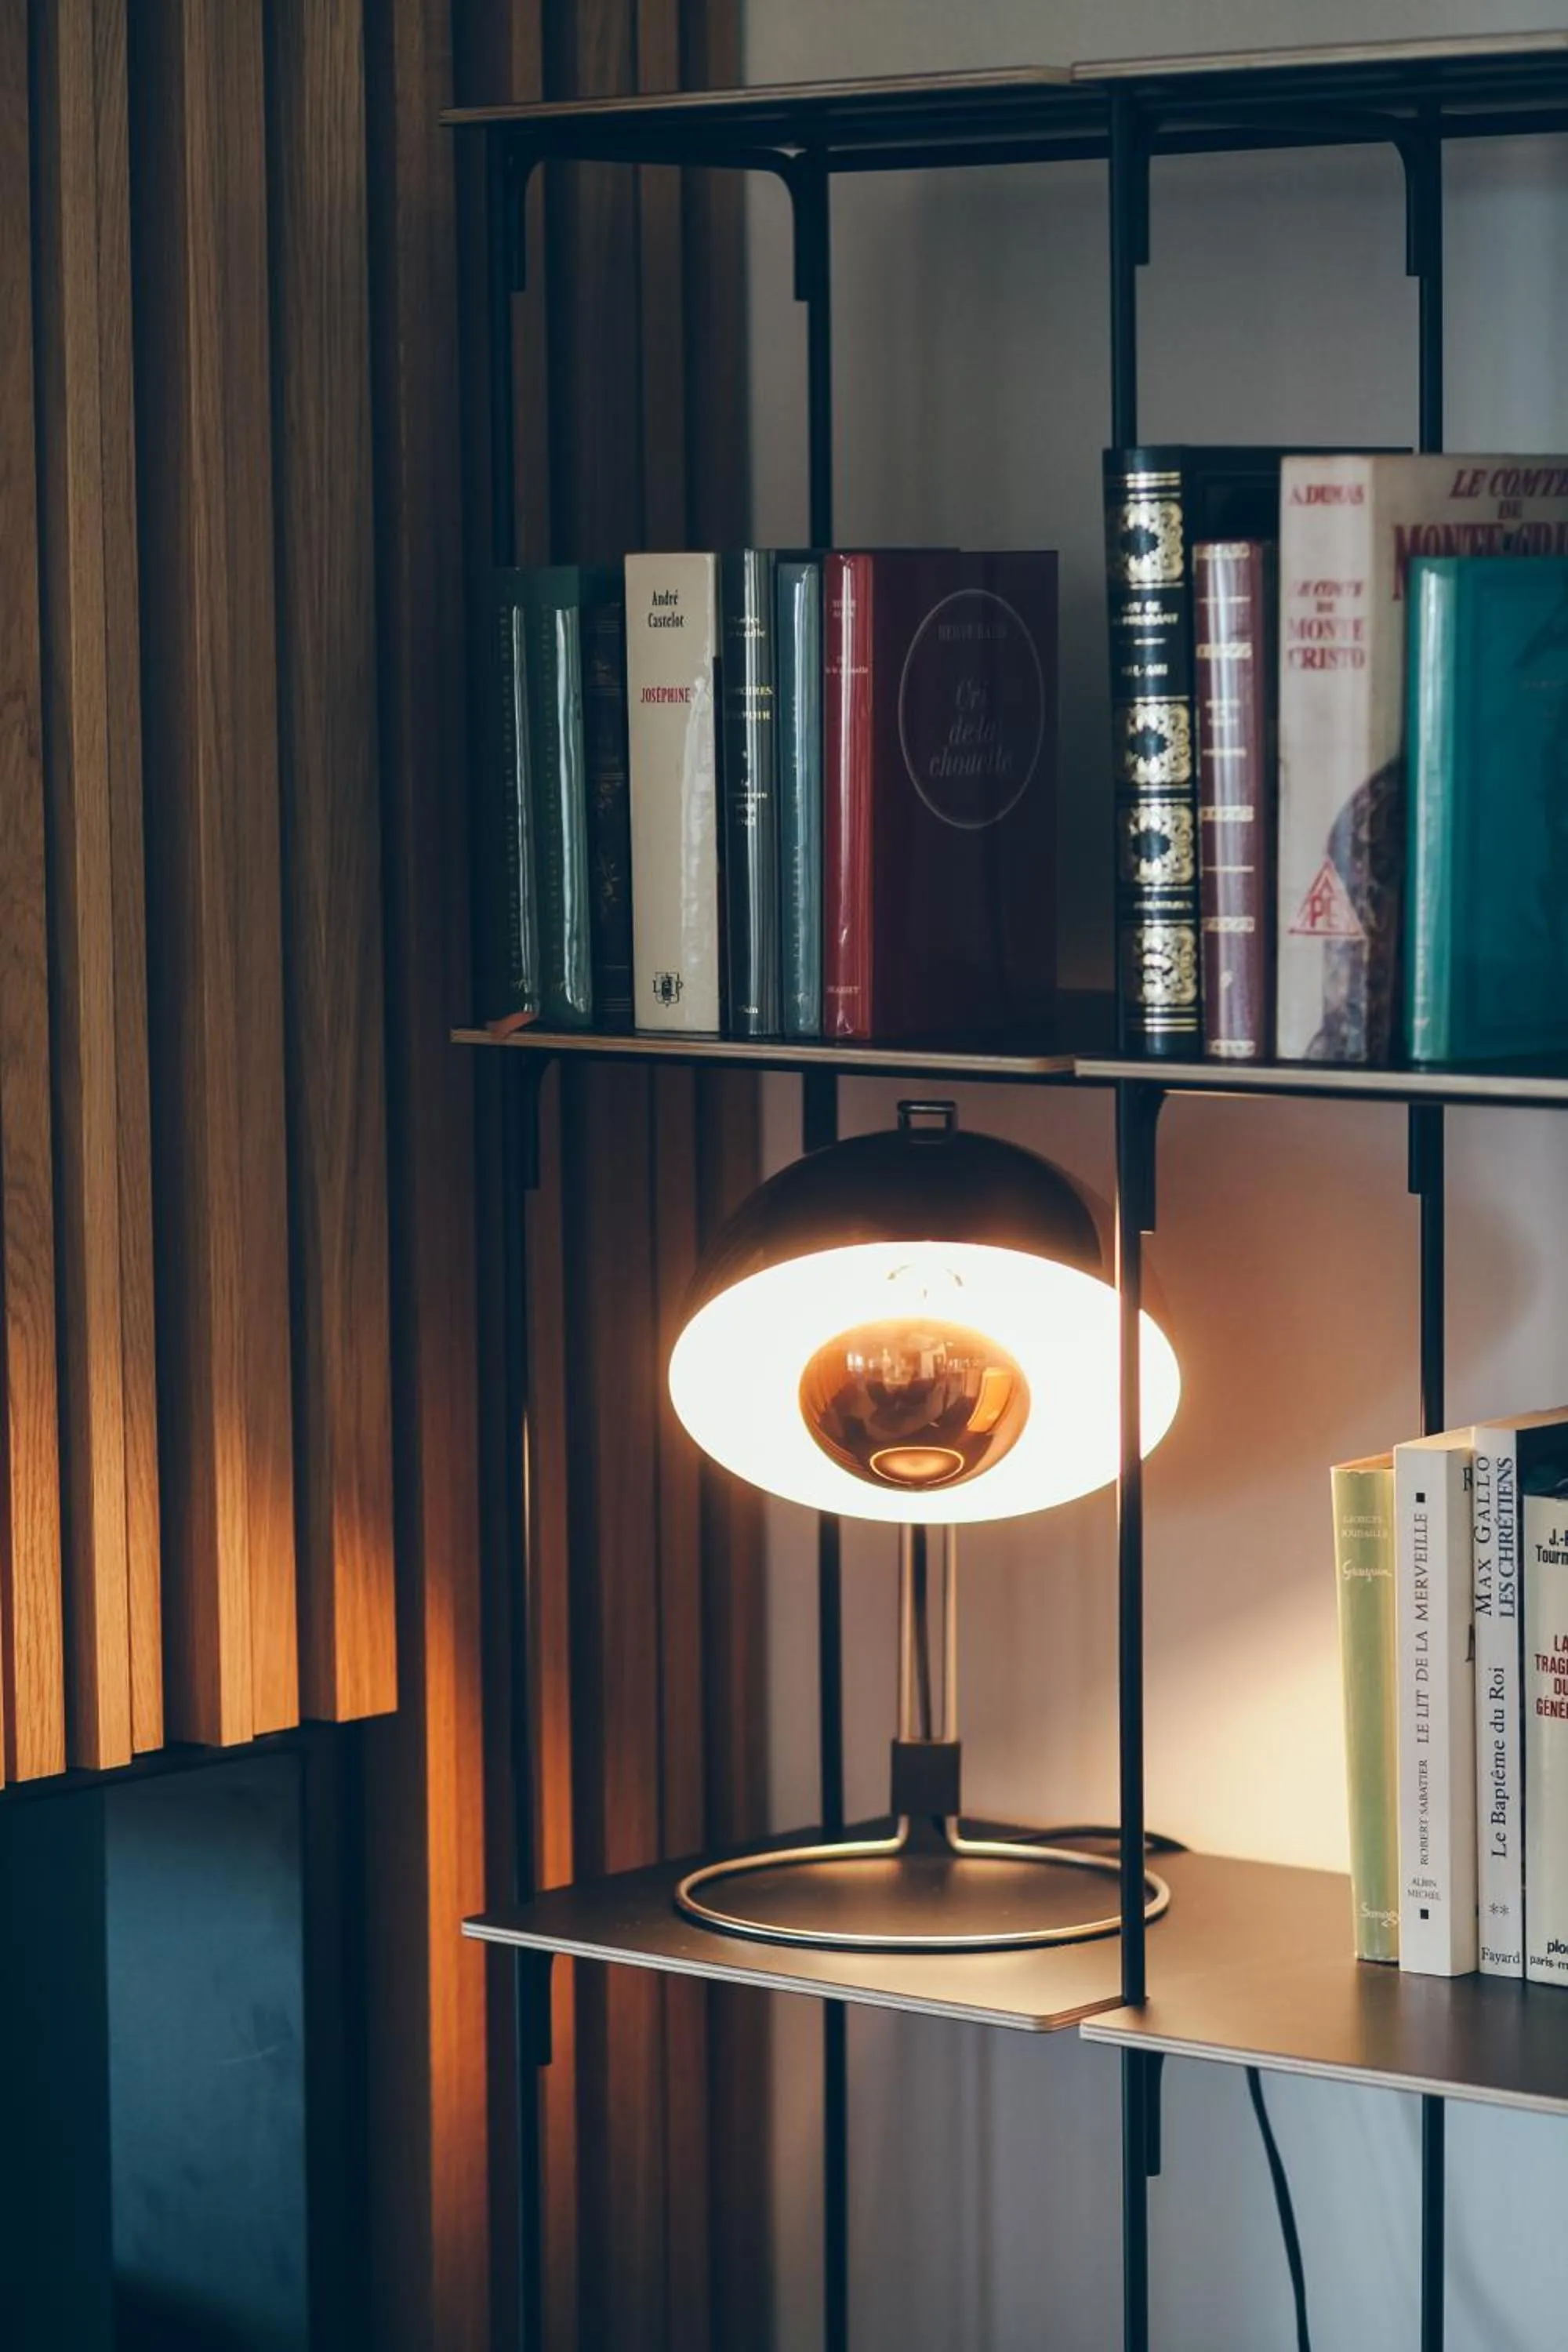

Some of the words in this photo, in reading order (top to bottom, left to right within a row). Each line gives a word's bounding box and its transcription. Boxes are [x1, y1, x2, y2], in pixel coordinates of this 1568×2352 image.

[1450, 468, 1487, 498] LE
[652, 590, 678, 606] André
[648, 612, 684, 628] Castelot
[1288, 646, 1365, 670] CRISTO
[641, 686, 690, 704] JOSÉPHINE
[1475, 1456, 1491, 1544] GALLO
[1494, 1457, 1515, 1577] CHRÉTIENS
[1414, 1513, 1428, 1621] MERVEILLE
[1475, 1559, 1492, 1616] MAX
[1498, 1581, 1515, 1618] LES
[1415, 1630, 1428, 1653] LA
[1416, 1657, 1429, 1682] DE
[1534, 1653, 1568, 1675] TRAG
[1488, 1667, 1505, 1700] Roi
[1416, 1689, 1429, 1718] LIT
[1536, 1695, 1568, 1719] GÉNÉ
[1417, 1723, 1429, 1743] LE
[1489, 1709, 1505, 1733] du
[1490, 1739, 1509, 1825] Baptême
[1491, 1831, 1506, 1858] Le
[1481, 1947, 1520, 1965] Fayard
